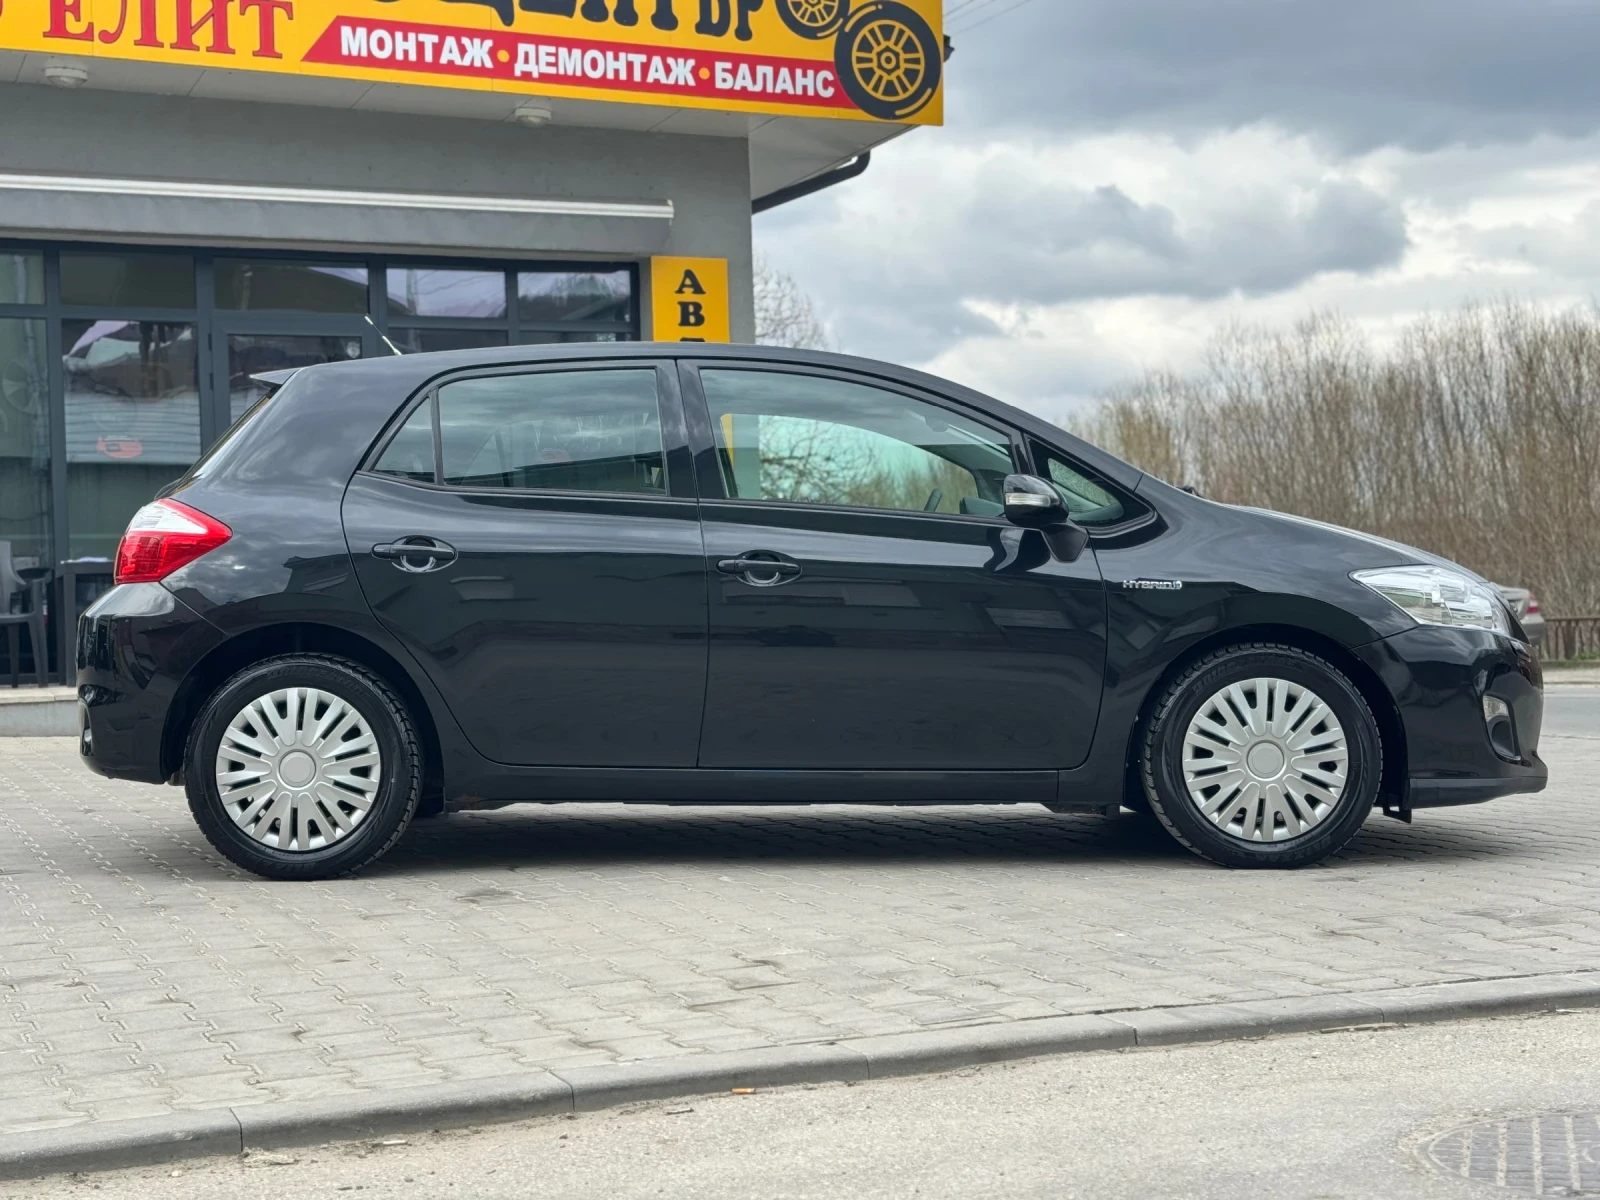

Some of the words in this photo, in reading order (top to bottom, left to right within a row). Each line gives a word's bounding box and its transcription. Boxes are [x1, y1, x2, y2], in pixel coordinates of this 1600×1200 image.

[340, 25, 494, 69] МОНТАЖ
[514, 42, 696, 87] ДЕМОНТАЖ
[714, 61, 835, 98] БАЛАНС
[675, 269, 706, 342] АВ
[1122, 580, 1173, 589] HYBRID
